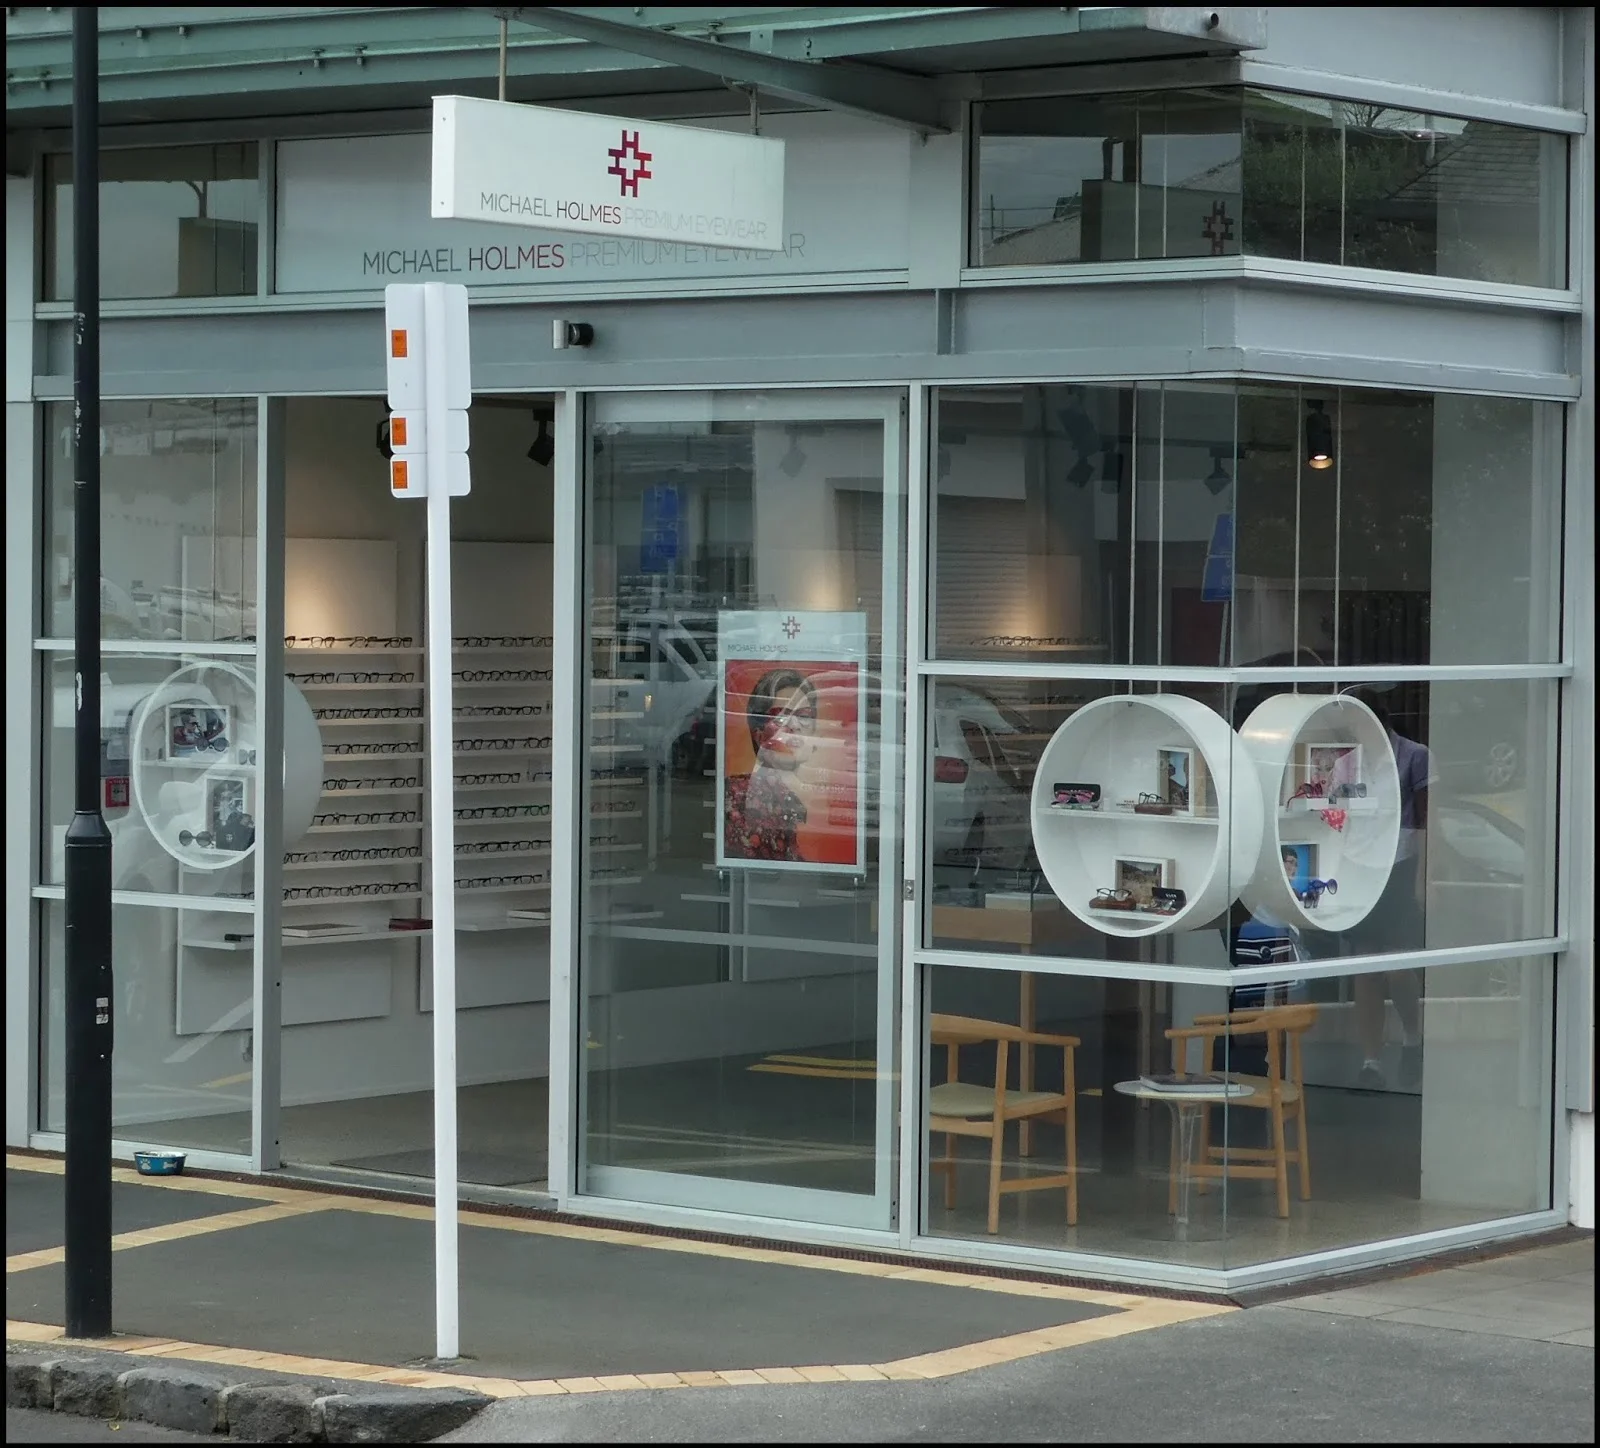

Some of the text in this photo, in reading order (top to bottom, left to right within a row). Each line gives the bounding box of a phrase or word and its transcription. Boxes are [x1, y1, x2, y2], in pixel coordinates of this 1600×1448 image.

[480, 192, 769, 240] MICHAEL HOLMES PREMIUM EYEWEAR
[363, 248, 462, 275] MICHAEL
[469, 244, 564, 270] HOLMES
[571, 240, 677, 267] PREMIUM
[727, 644, 757, 653] MICHAEL
